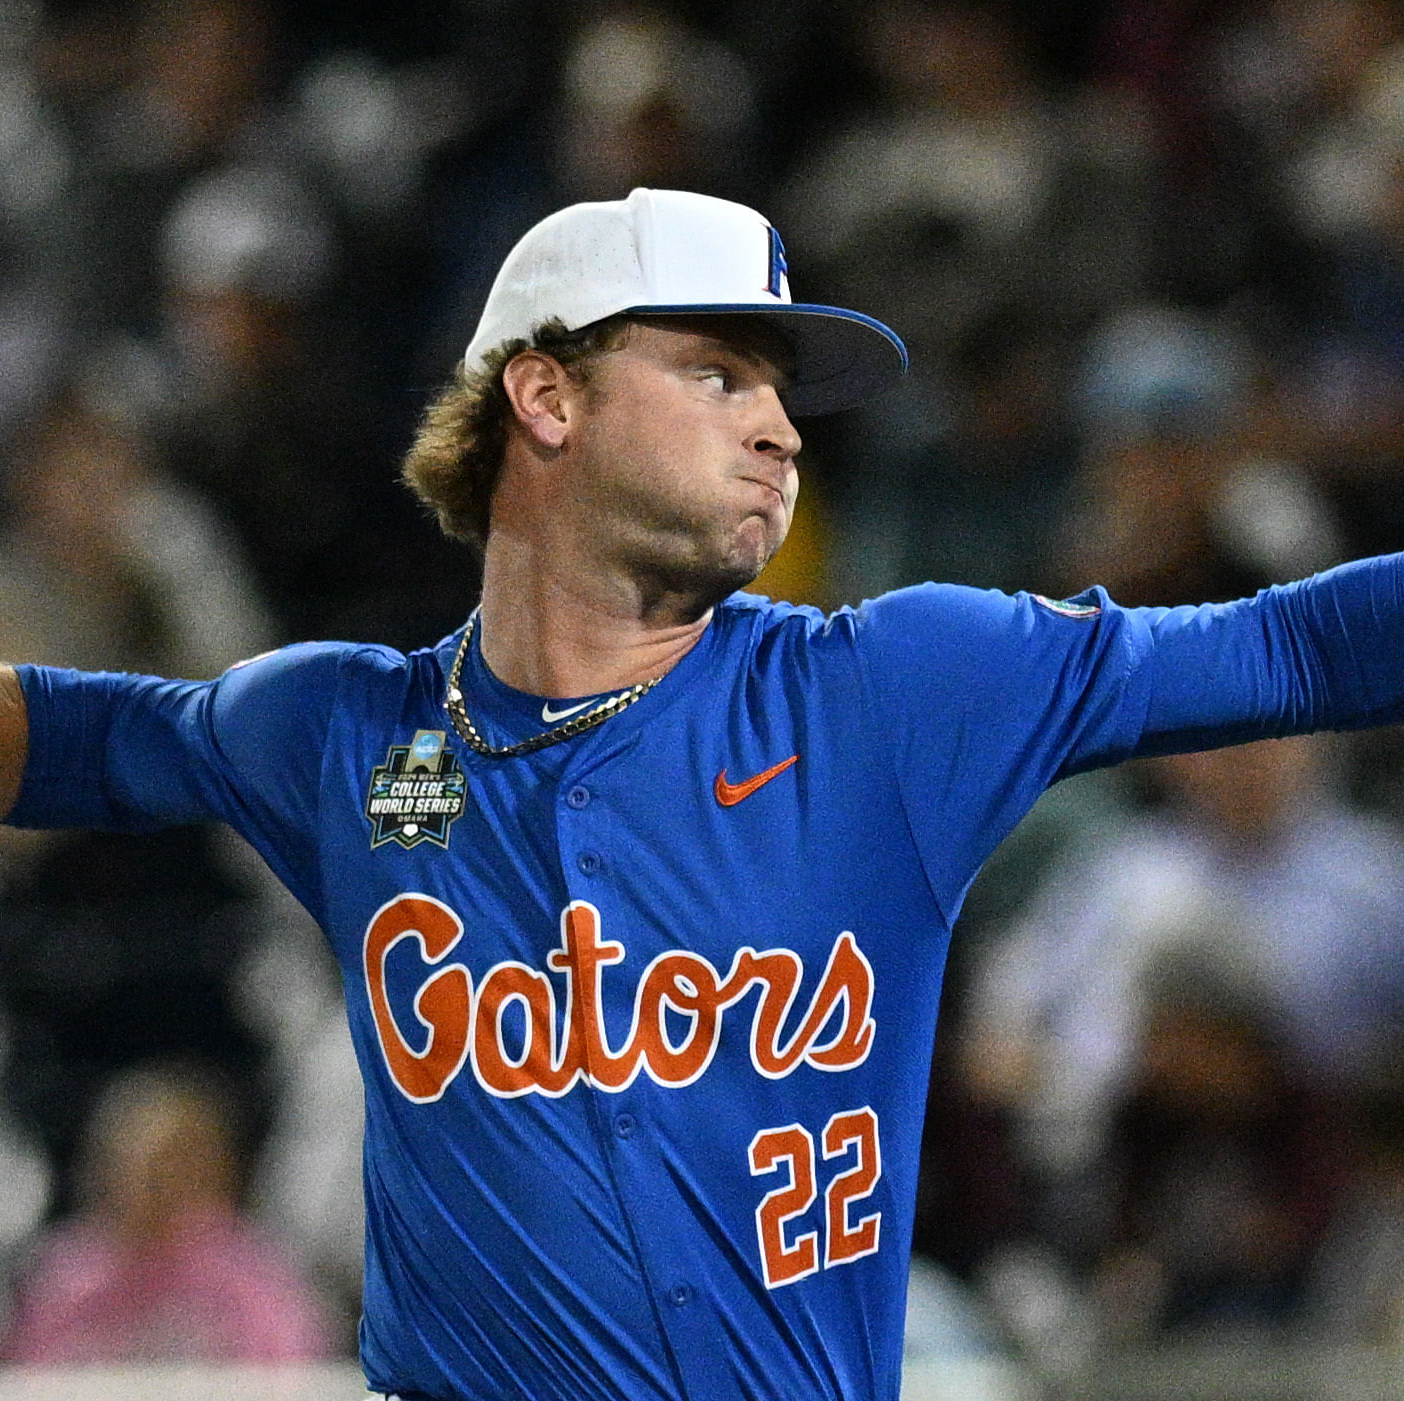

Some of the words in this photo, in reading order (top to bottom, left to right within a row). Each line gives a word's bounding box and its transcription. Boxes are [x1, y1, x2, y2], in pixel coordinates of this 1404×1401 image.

[370, 798, 415, 814] WORLD
[414, 797, 461, 814] SERIES
[389, 781, 446, 797] COLLEGE
[362, 892, 876, 1105] Gators
[747, 1105, 883, 1291] 22
